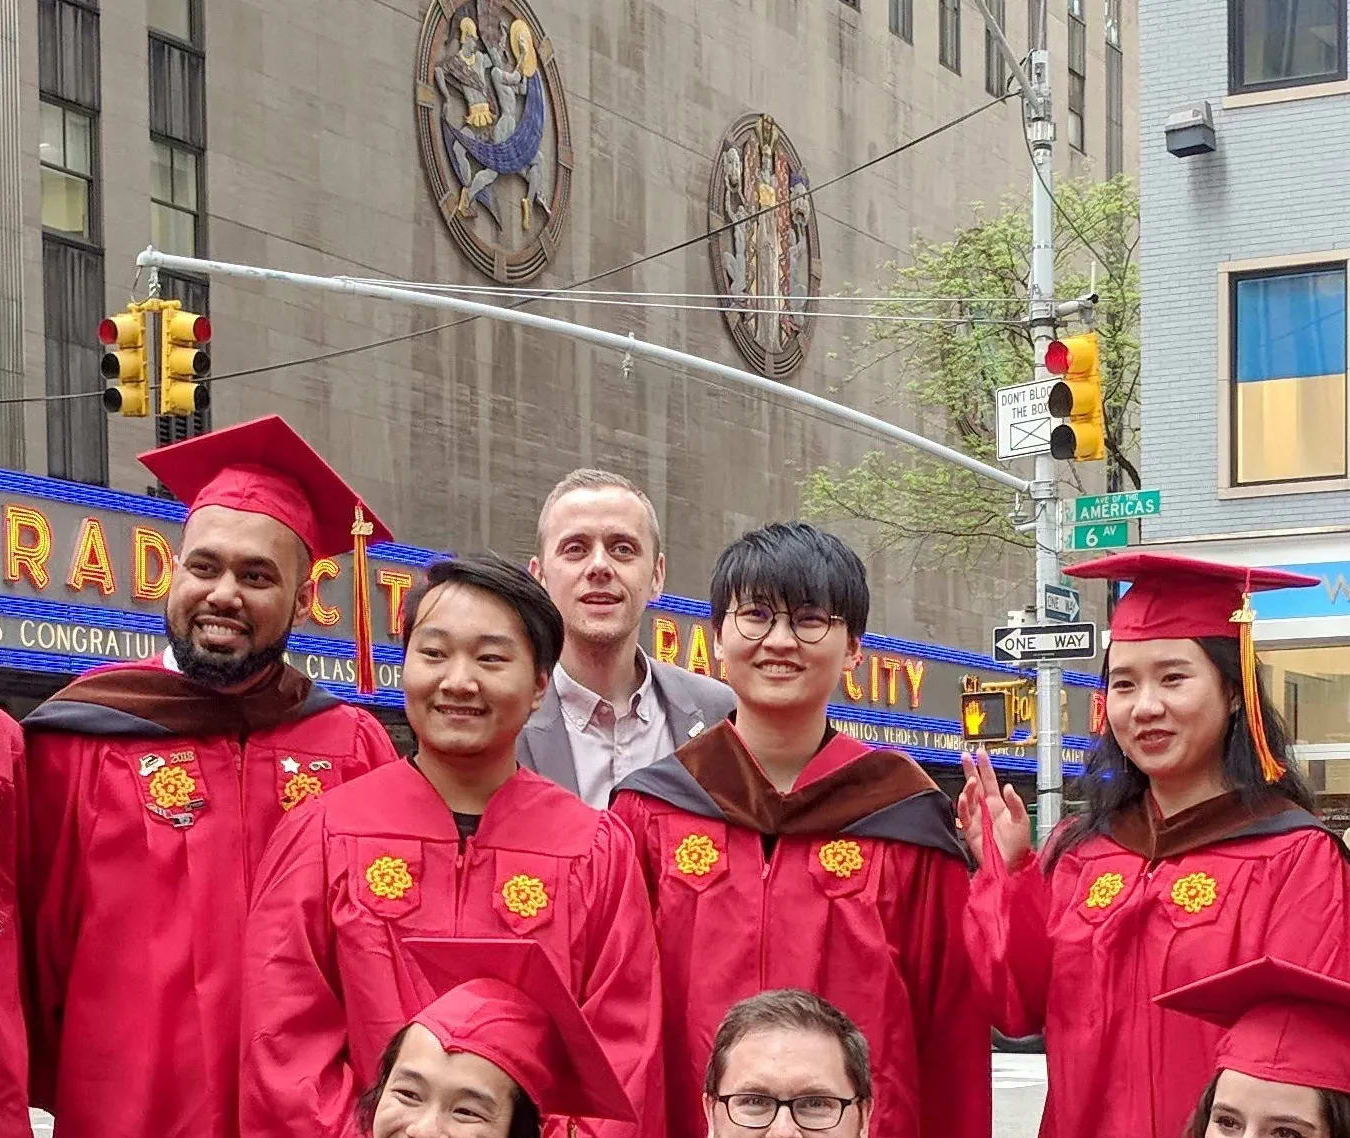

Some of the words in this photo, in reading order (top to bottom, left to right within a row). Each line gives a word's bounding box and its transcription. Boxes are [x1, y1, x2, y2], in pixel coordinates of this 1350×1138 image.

[1001, 391, 1026, 406] DON'T
[1029, 386, 1052, 400] BLOC
[1012, 406, 1027, 418] THE
[1031, 402, 1049, 415] BOX
[1112, 495, 1121, 503] OF
[1126, 493, 1139, 501] THE
[1080, 499, 1155, 520] AMERICAS
[1085, 527, 1099, 547] 6
[1103, 525, 1117, 536] AV
[2, 504, 175, 602] RAD
[310, 557, 414, 637] CT
[1005, 635, 1036, 651] ONE
[1054, 633, 1085, 648] WAY
[306, 653, 356, 684] CLAS
[379, 664, 402, 687] OF
[883, 726, 919, 746] VERDES
[923, 730, 930, 748] Y
